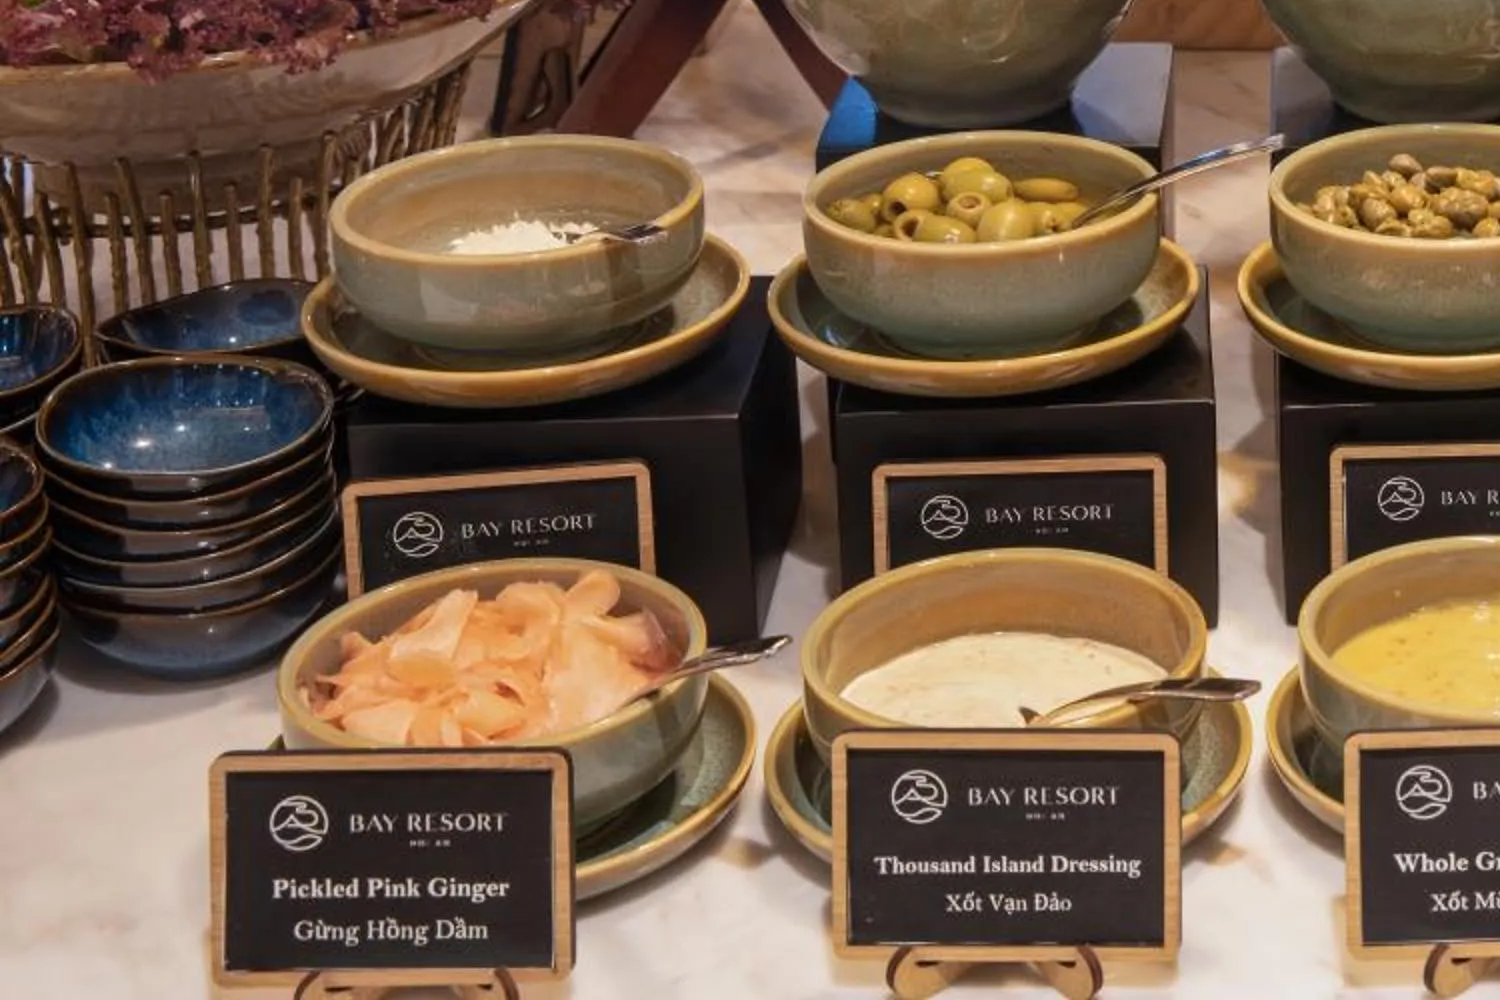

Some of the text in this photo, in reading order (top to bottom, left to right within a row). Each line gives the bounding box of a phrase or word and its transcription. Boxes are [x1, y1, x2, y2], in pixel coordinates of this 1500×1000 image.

[1441, 490, 1478, 506] BAY
[985, 504, 1115, 524] BAY RESORT
[461, 513, 596, 539] BAY RESORT
[968, 786, 1120, 806] BAY RESORT
[350, 812, 509, 833] BAY RESORT
[873, 855, 1142, 878] Thousand Island Dressing
[1393, 853, 1469, 873] Whole
[272, 877, 510, 903] Pickled Pink Ginger
[946, 891, 1072, 915] Xốt Vạn Đảo
[1430, 891, 1468, 912] Xốt
[294, 919, 358, 946] Gừng
[366, 917, 428, 945] Hồng
